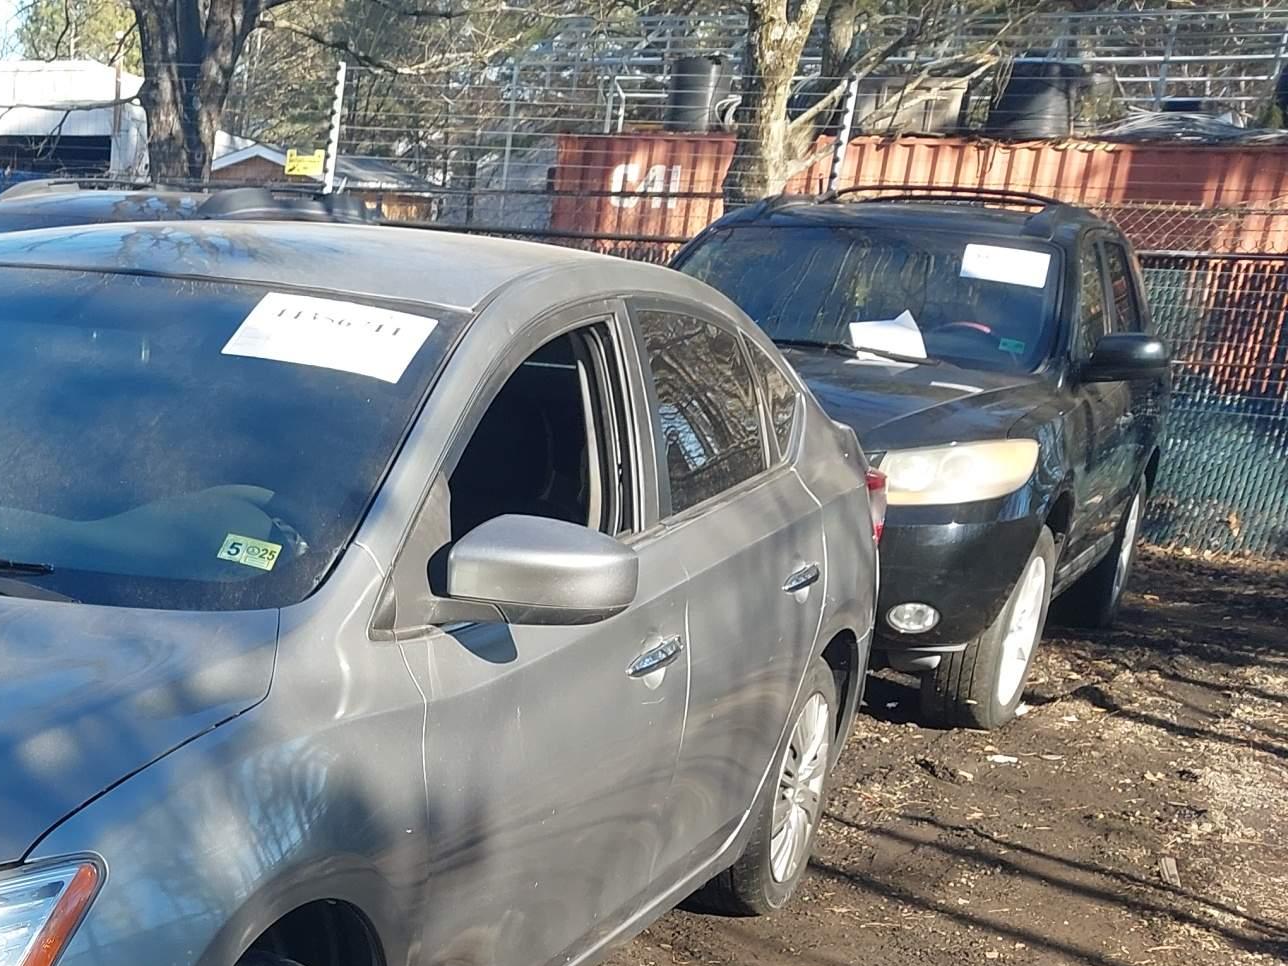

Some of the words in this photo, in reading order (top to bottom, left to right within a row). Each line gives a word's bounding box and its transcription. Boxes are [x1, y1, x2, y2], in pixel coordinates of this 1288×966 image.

[610, 163, 682, 209] CAI
[227, 541, 243, 556] 5
[258, 548, 277, 561] 25
